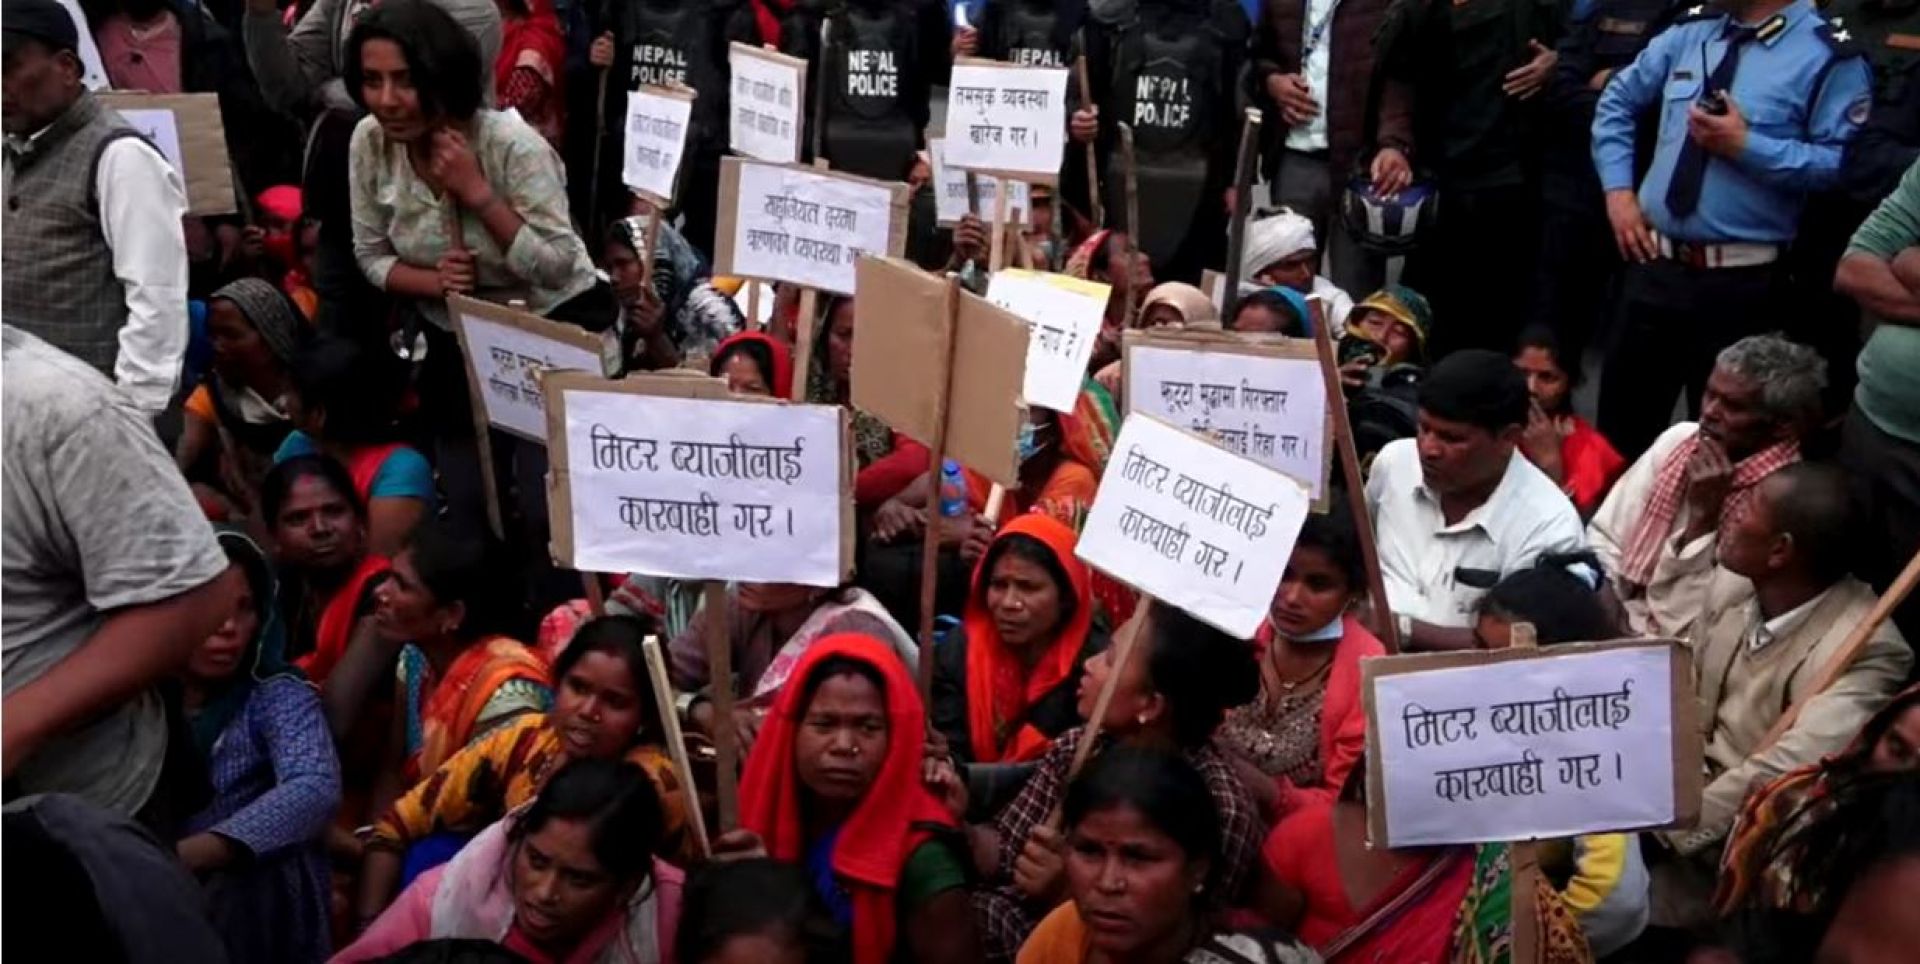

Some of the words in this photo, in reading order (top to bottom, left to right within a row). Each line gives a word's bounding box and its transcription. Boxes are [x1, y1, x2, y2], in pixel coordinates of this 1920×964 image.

[633, 44, 688, 67] NEPAL
[631, 65, 686, 86] POLICE
[848, 73, 898, 96] POLICE
[1010, 126, 1028, 148] गर
[590, 423, 658, 472] मिटर
[1120, 444, 1170, 493] मिटर
[733, 503, 773, 538] गर
[1194, 540, 1229, 578] गर
[1403, 703, 1477, 748] मिटर
[1558, 754, 1602, 790] गर
